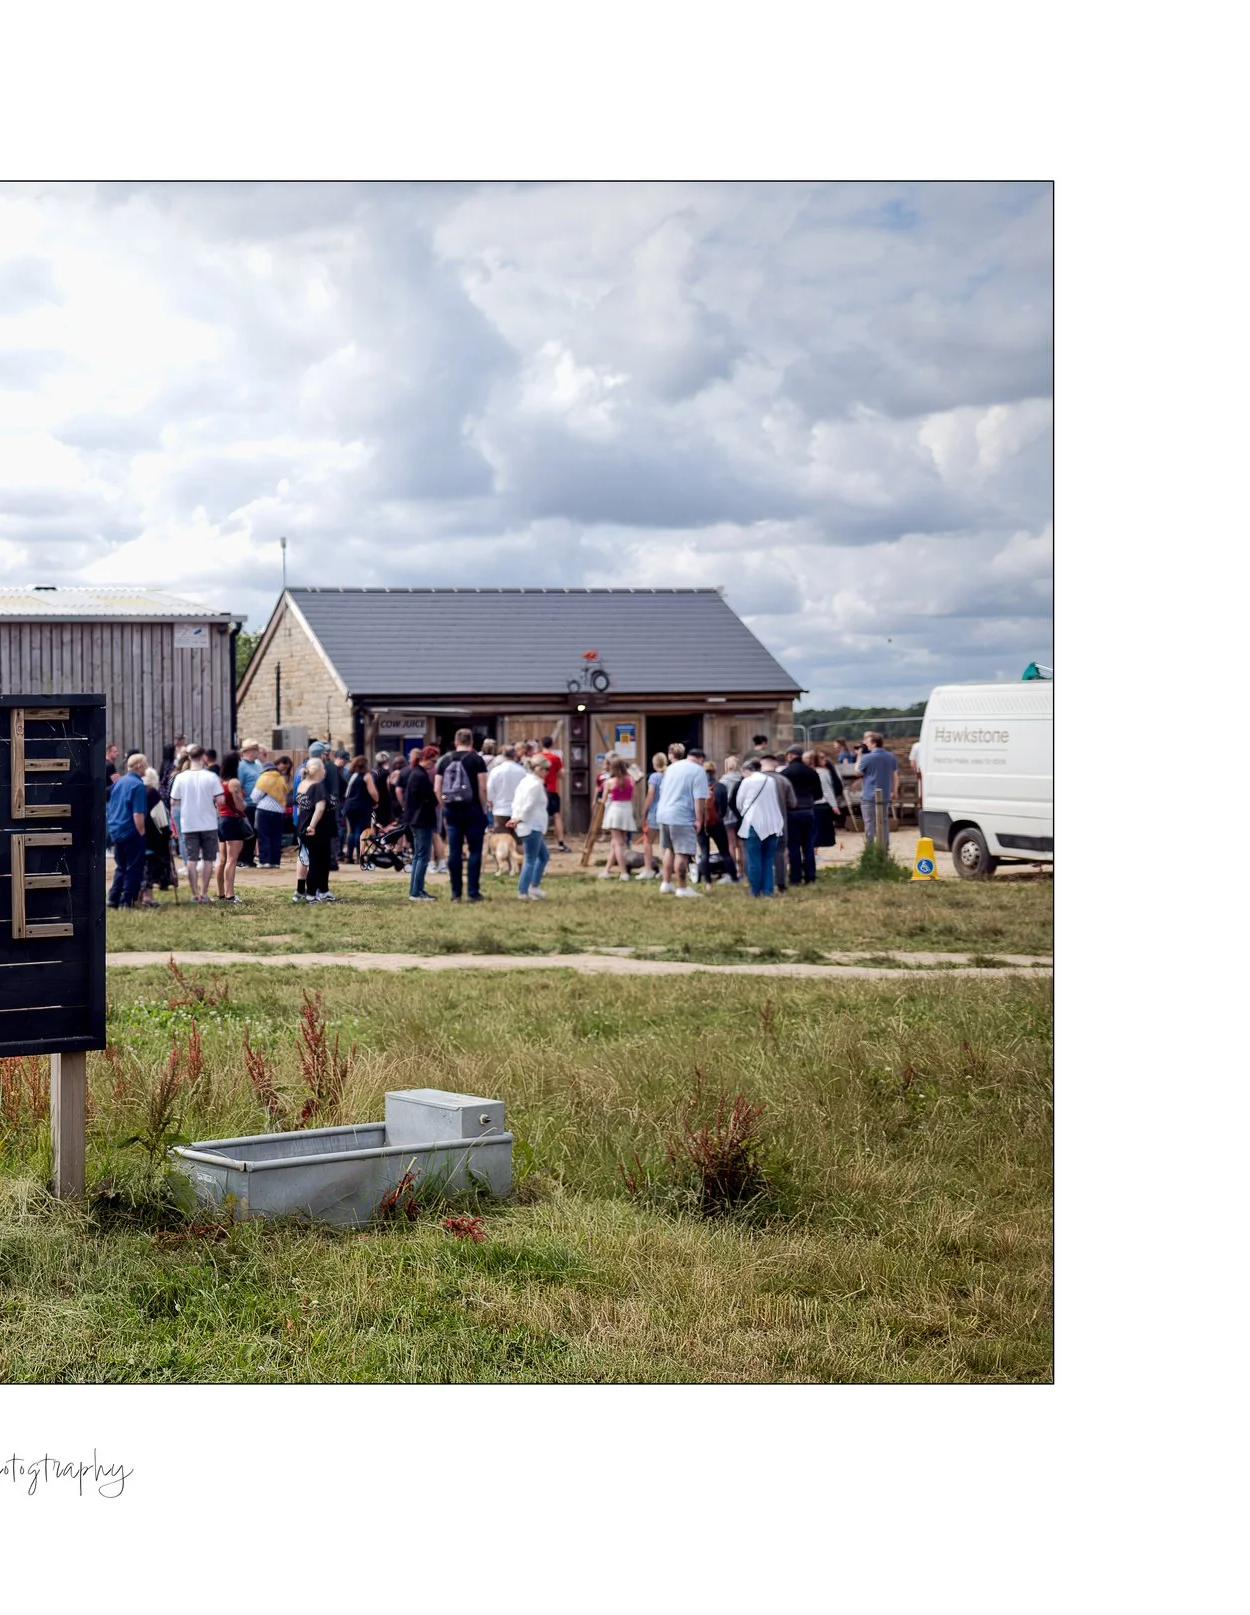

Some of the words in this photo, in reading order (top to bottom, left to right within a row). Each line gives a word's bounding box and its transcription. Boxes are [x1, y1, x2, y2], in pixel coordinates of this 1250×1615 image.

[380, 719, 400, 729] COW
[401, 719, 425, 729] JUICE
[934, 726, 1010, 743] Hawkstone
